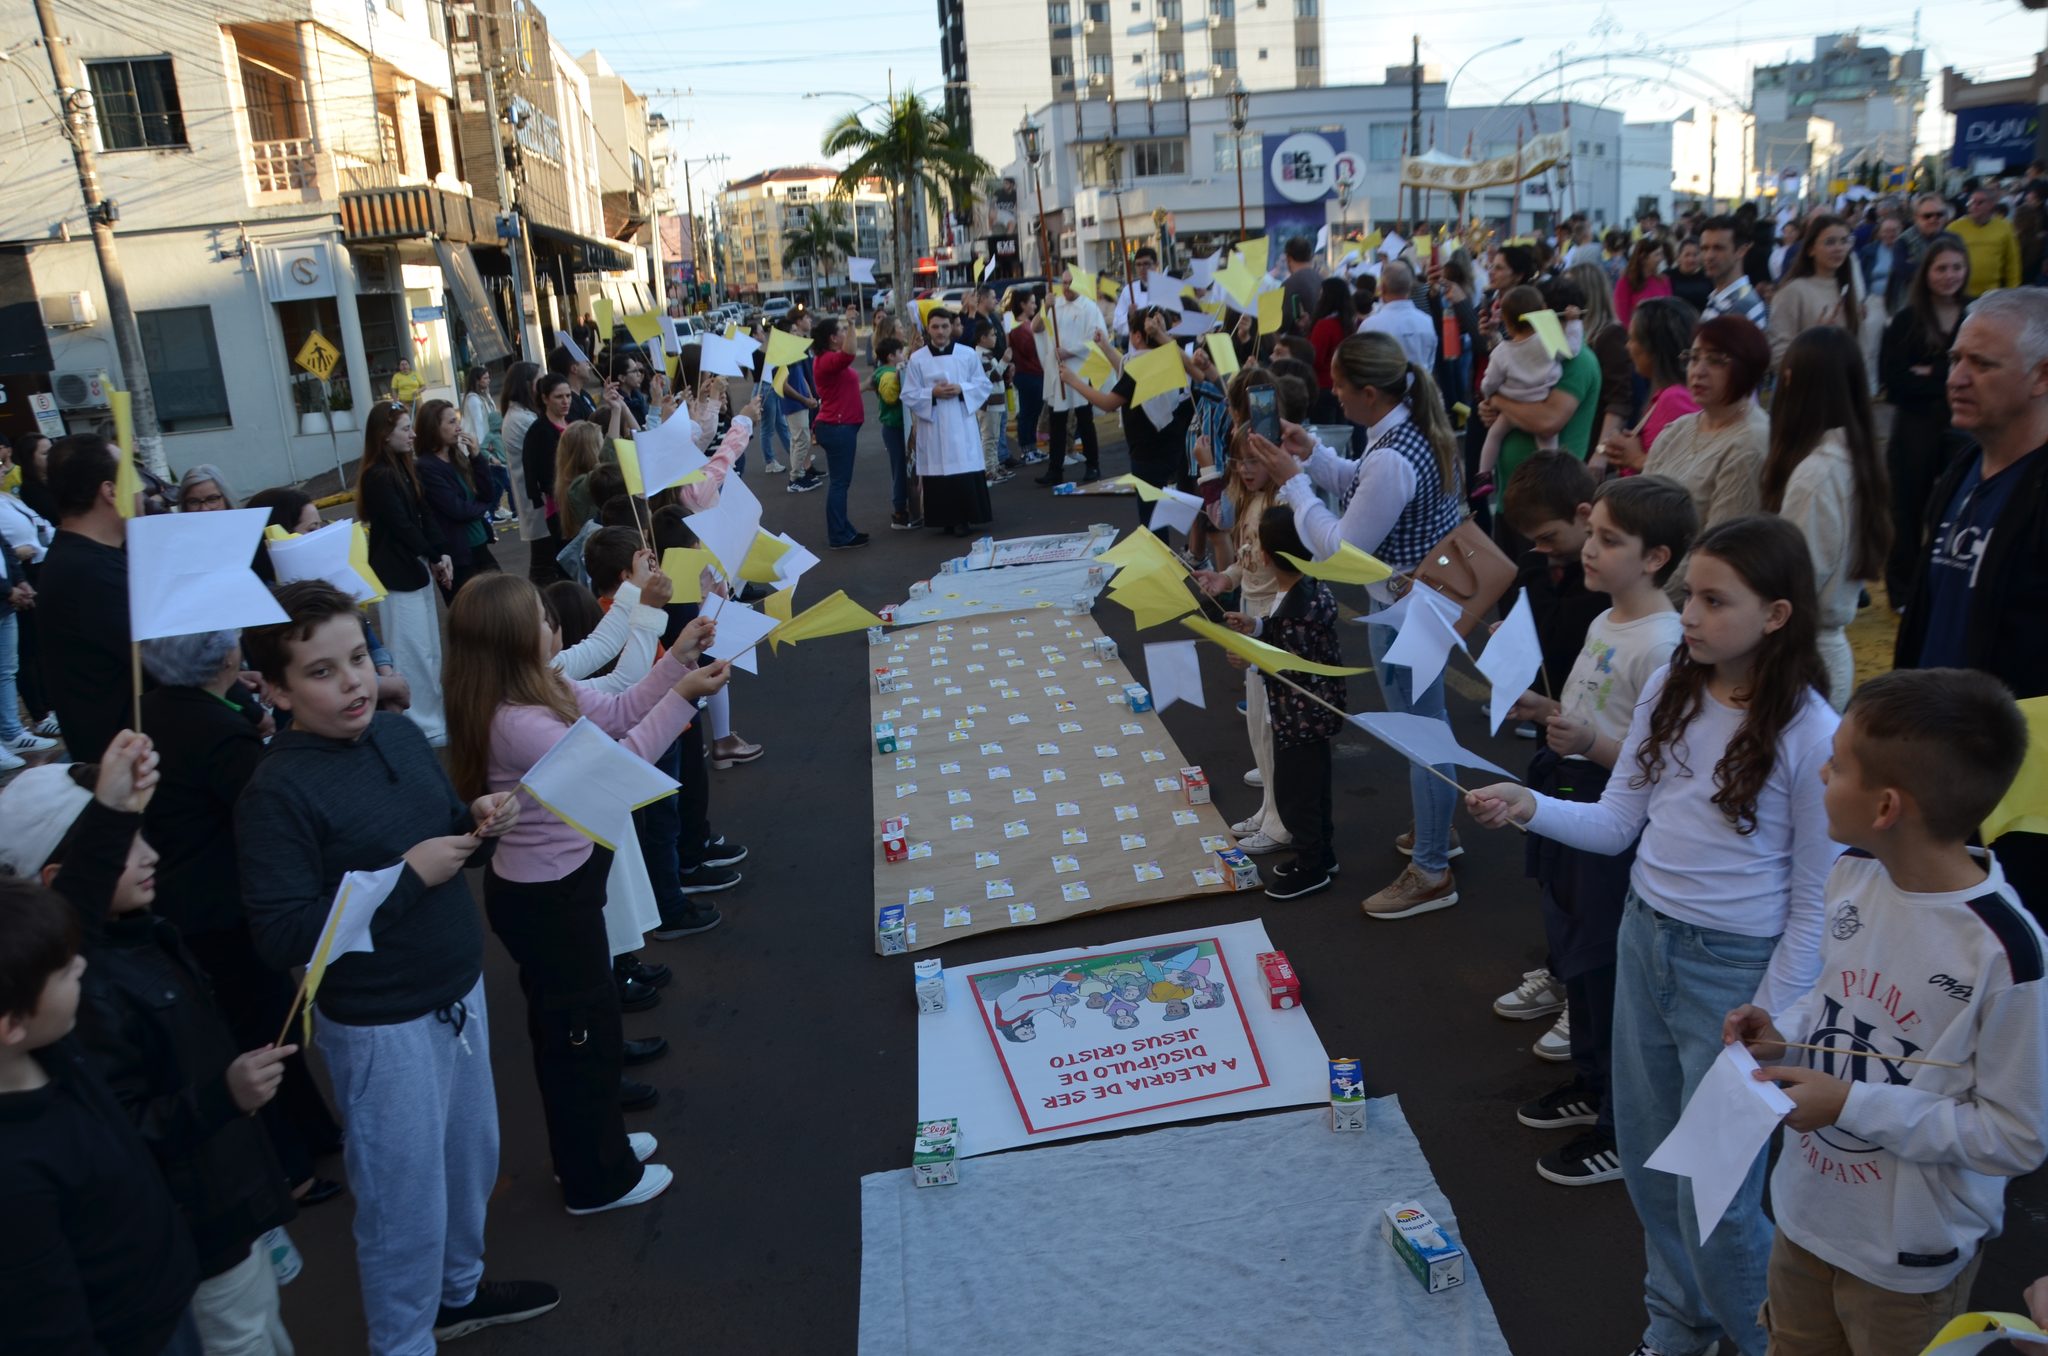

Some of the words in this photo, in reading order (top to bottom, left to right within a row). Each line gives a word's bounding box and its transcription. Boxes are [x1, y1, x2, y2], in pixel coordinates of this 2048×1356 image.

[1132, 1027, 1199, 1051] JESUS
[1050, 1043, 1127, 1068] CRISTO
[1093, 1045, 1208, 1078] DISCÍPULO
[1221, 1057, 1237, 1070] A
[1058, 1070, 1088, 1086] DE
[1125, 1062, 1216, 1092] ALEGRIA
[1041, 1090, 1087, 1109] SER
[1091, 1083, 1123, 1099] DE
[1800, 1134, 1882, 1184] OMPANY
[1397, 1213, 1425, 1223] Aurora
[1401, 1219, 1433, 1231] Integral
